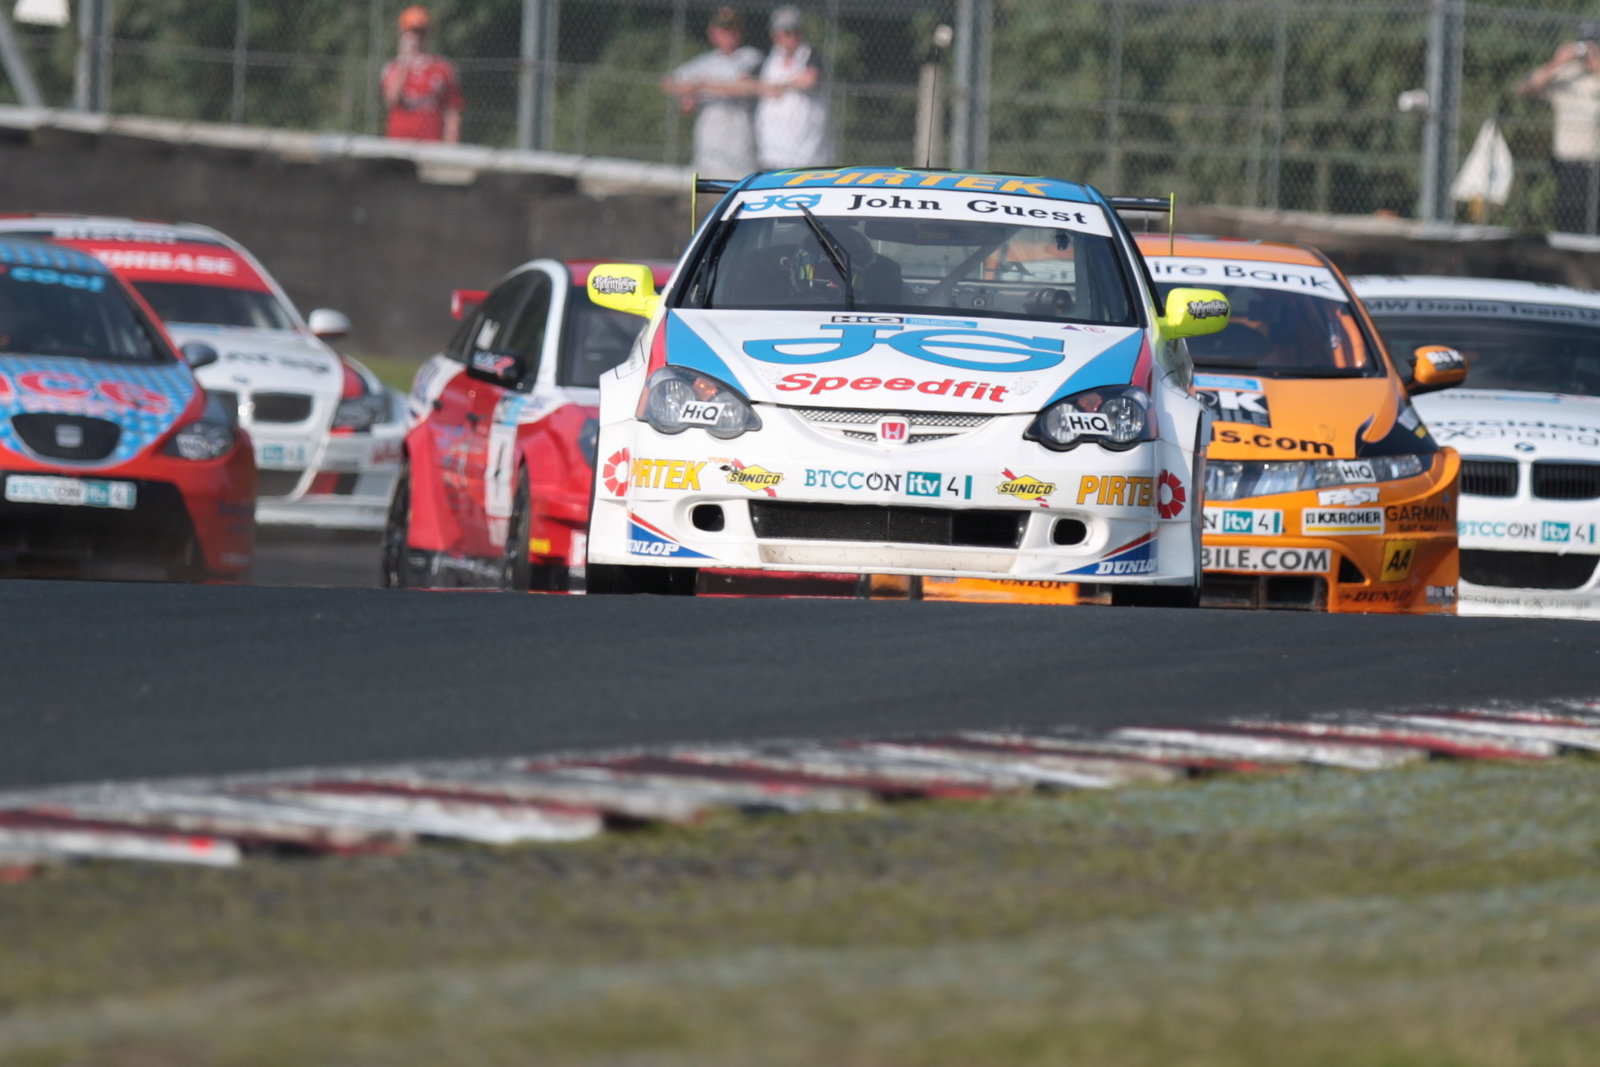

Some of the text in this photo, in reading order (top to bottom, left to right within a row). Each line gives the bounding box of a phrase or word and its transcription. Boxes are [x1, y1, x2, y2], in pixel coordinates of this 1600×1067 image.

[783, 171, 1049, 197] PIRTEK
[847, 193, 1088, 225] John Guest
[1154, 260, 1336, 291] ire Bank
[1362, 299, 1408, 312] MW
[1415, 299, 1499, 314] Dealer
[1508, 303, 1574, 319] Team
[833, 316, 902, 324] HiQ
[743, 323, 1066, 373] JG
[775, 372, 1010, 403] Speedfit
[681, 403, 719, 421] HiQ
[1069, 415, 1109, 432] HiQ
[1211, 429, 1336, 456] s.com
[729, 472, 782, 485] SUNOCO
[1341, 461, 1374, 478] HiQ
[907, 472, 941, 496] itv
[1000, 482, 1054, 495] SUNOCO
[1223, 511, 1252, 532] itv
[1385, 505, 1450, 521] GARMIN
[1542, 521, 1570, 541] itv
[1201, 547, 1328, 571] BILE.COM
[1387, 548, 1412, 572] AA
